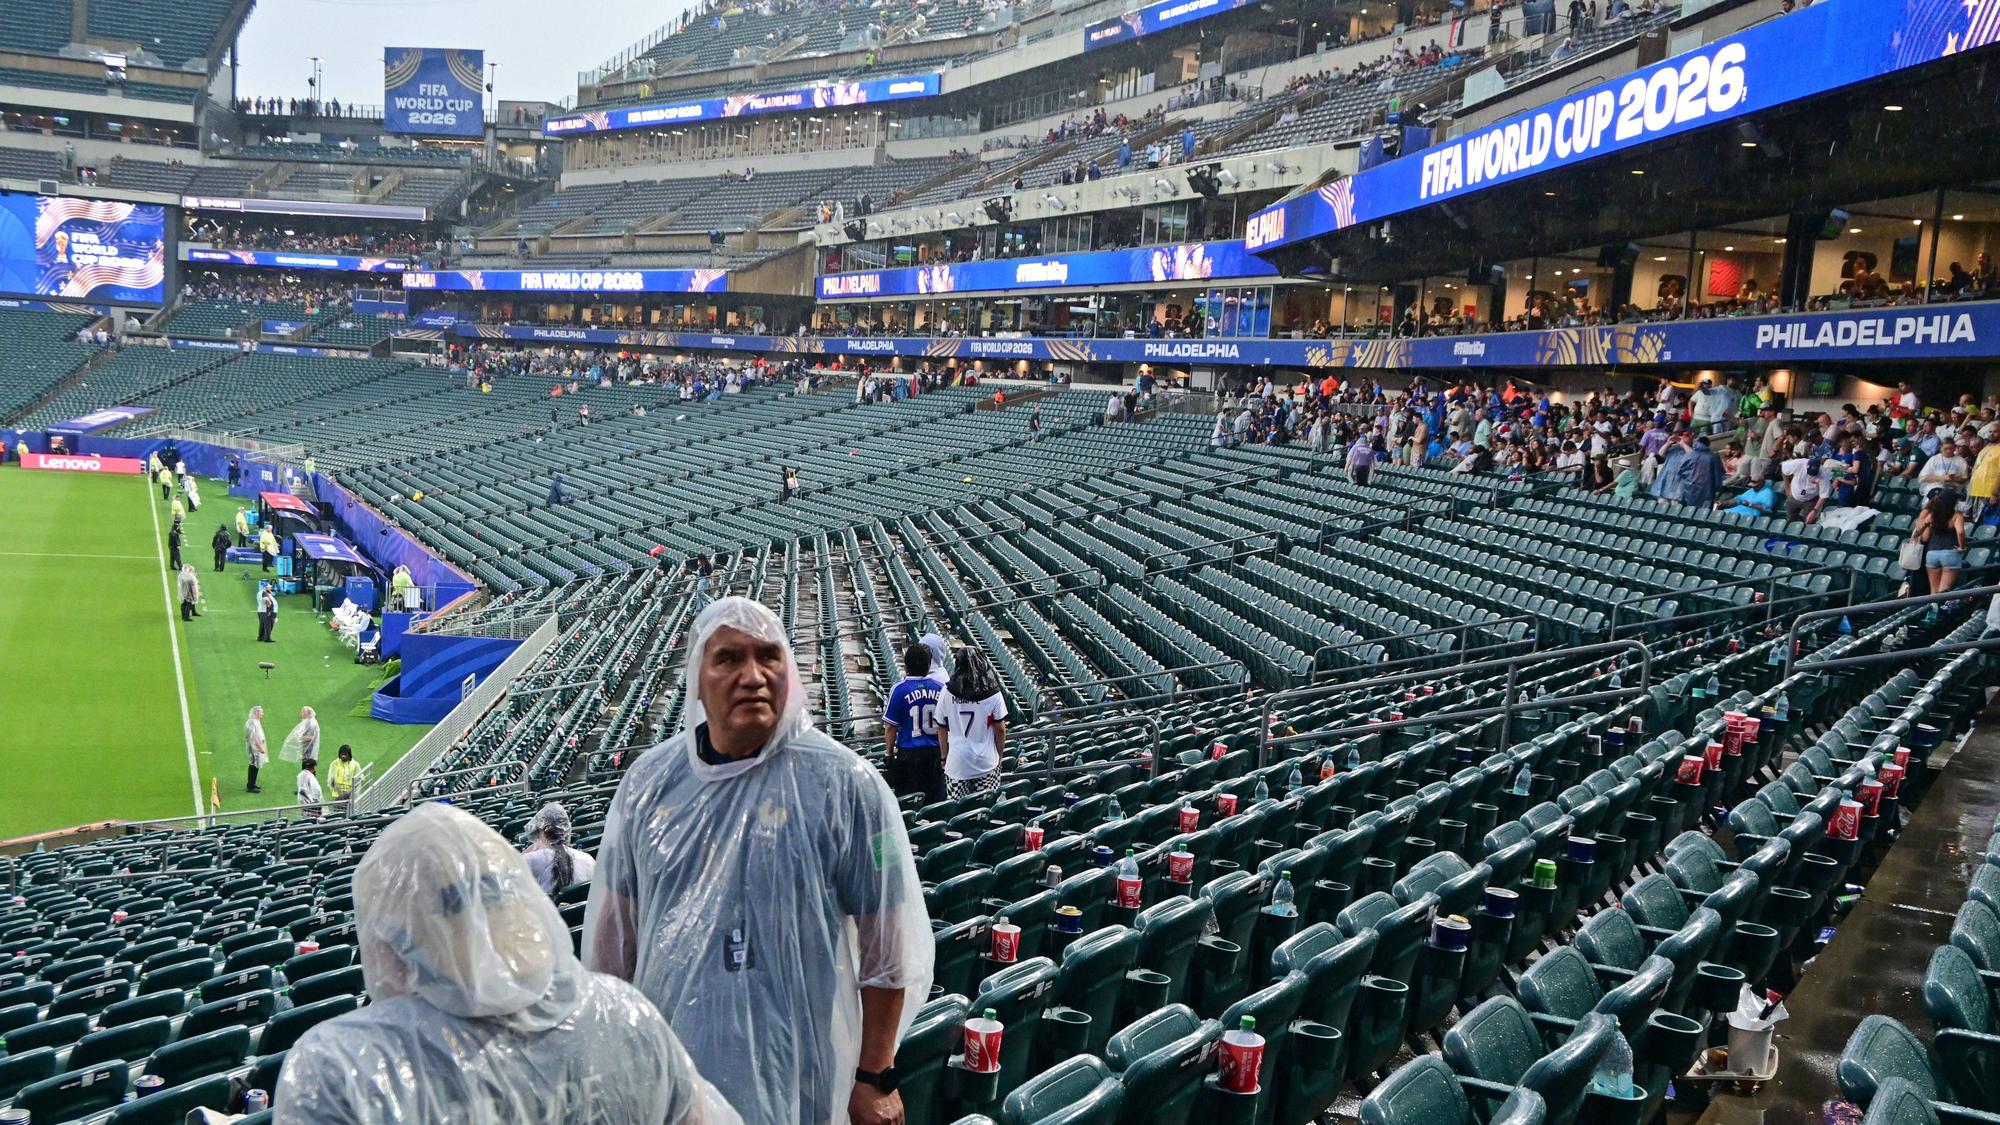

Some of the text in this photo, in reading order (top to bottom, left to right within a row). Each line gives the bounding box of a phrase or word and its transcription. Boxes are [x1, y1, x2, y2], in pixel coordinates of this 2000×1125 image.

[419, 84, 448, 97] FIFA
[395, 97, 474, 112] WORLD CUP
[408, 112, 457, 126] 2026
[1420, 43, 1746, 199] FIFA WORLD CUP 2026
[71, 242, 118, 256] WORLD
[521, 272, 643, 290] FIFA WORLD CUP 2026
[823, 274, 880, 295] PHILADELPHIA
[533, 329, 587, 340] PHILADELPHIA
[1756, 313, 1976, 349] PHILADELPHIA
[847, 340, 894, 351] PHILADELPHIA
[970, 342, 1033, 354] FIFA WORLD CUP 2026
[1144, 343, 1240, 358] PHILADELPHIA
[40, 455, 101, 470] Lenovo
[261, 470, 273, 481] FIFA
[909, 704, 939, 738] 10
[959, 710, 975, 738] 7
[1837, 808, 1856, 837] Cola
[967, 1038, 980, 1068] Cola
